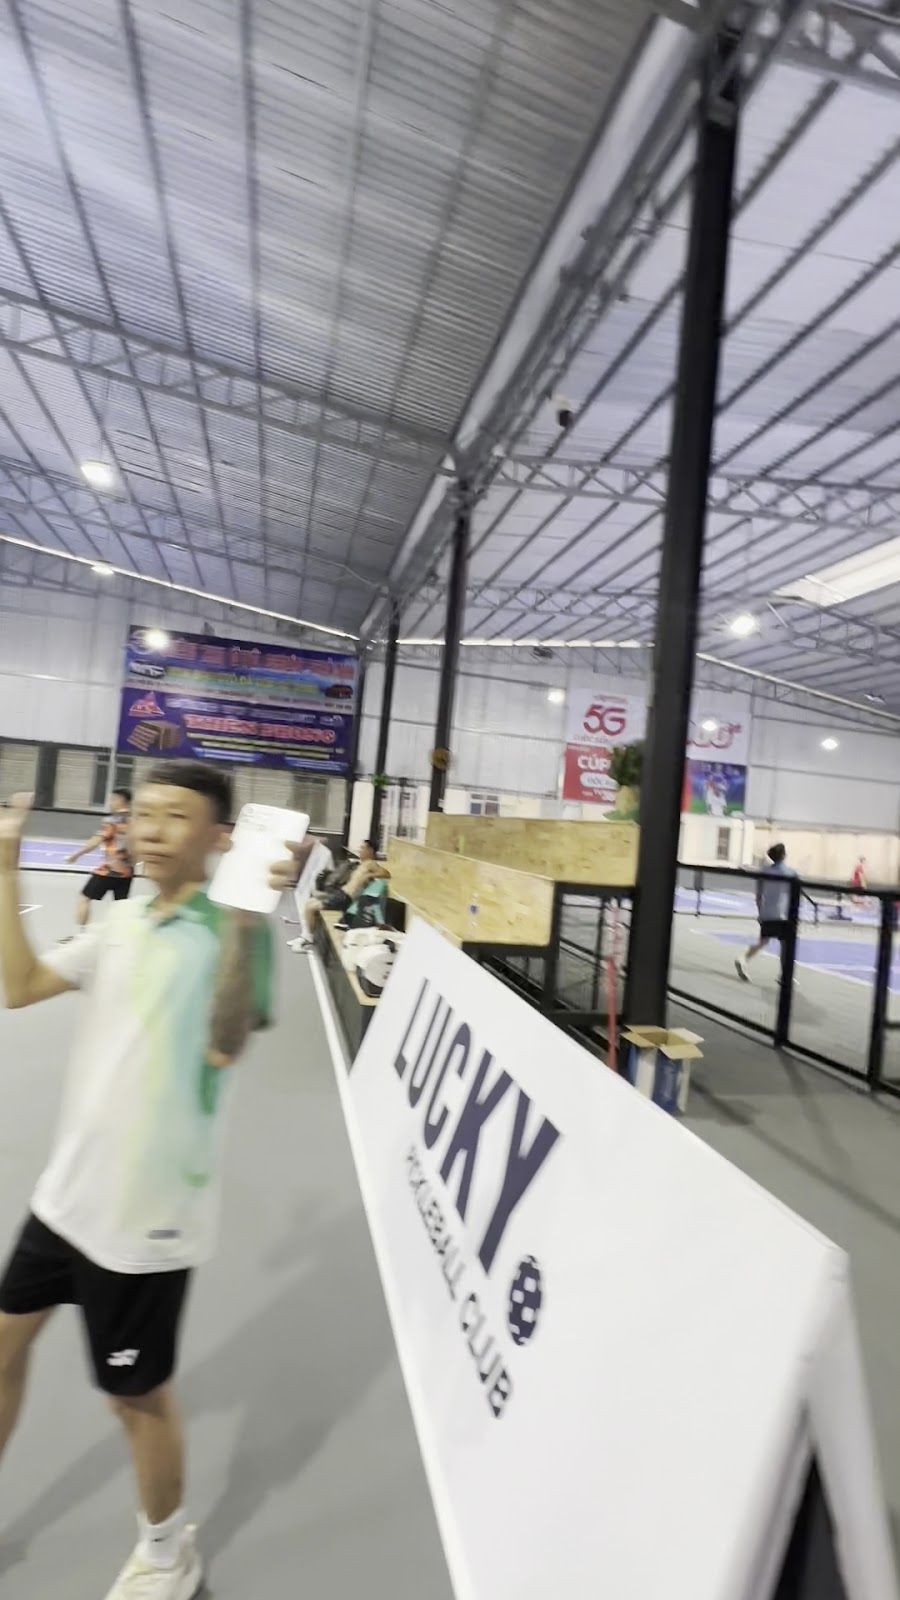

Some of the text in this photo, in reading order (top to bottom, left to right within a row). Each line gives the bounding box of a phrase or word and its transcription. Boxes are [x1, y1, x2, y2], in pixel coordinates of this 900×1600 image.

[583, 704, 627, 737] 5G
[394, 977, 561, 1277] LUCKY
[460, 1293, 512, 1419] CLUB
